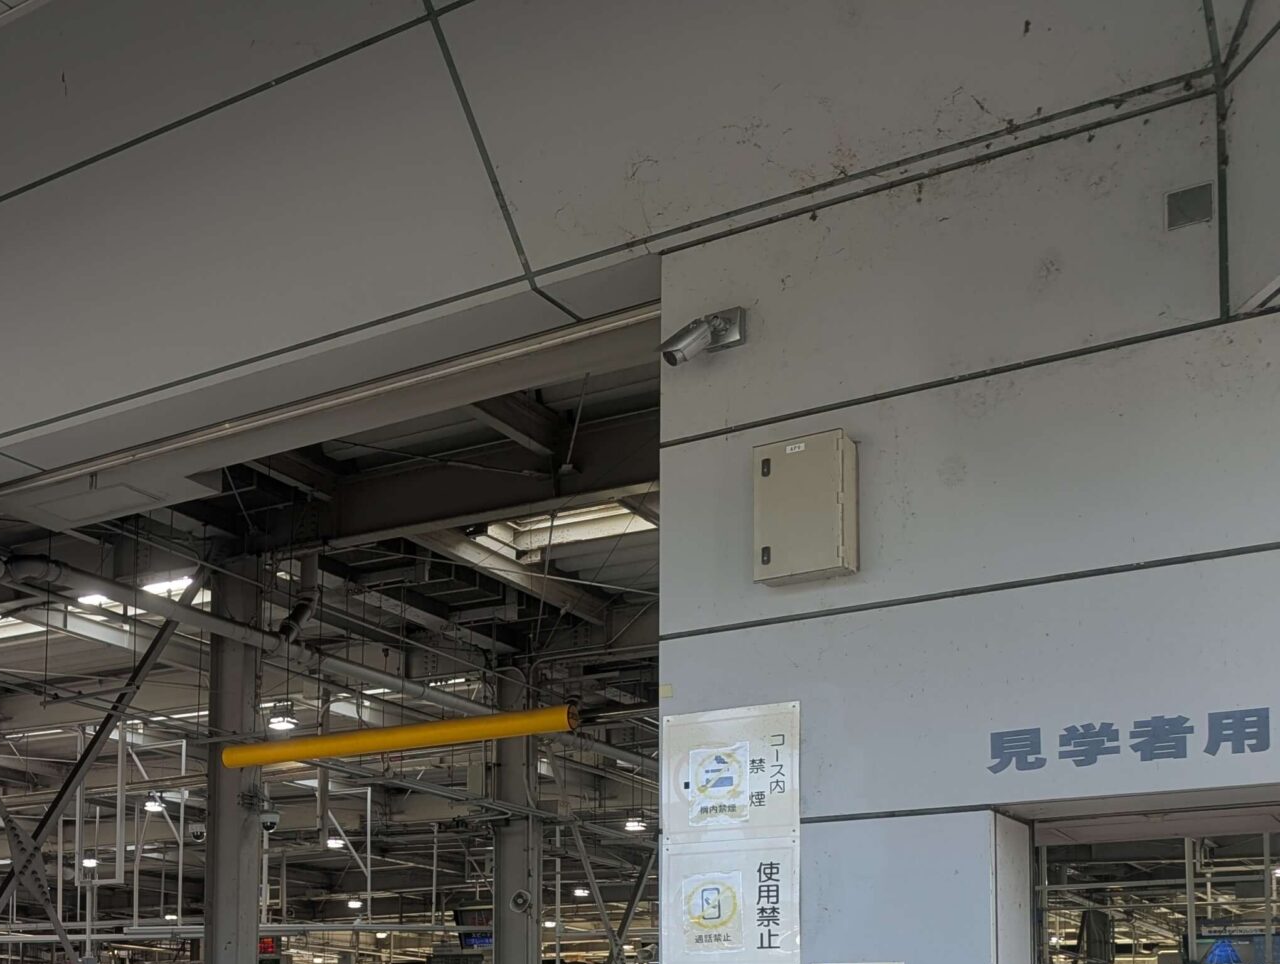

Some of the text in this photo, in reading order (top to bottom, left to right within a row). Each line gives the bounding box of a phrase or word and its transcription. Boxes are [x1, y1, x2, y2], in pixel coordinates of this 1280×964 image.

[770, 733, 785, 794] コース内
[986, 707, 1270, 775] 見学者用
[749, 757, 766, 808] 禁煙
[756, 862, 781, 950] 使用禁止
